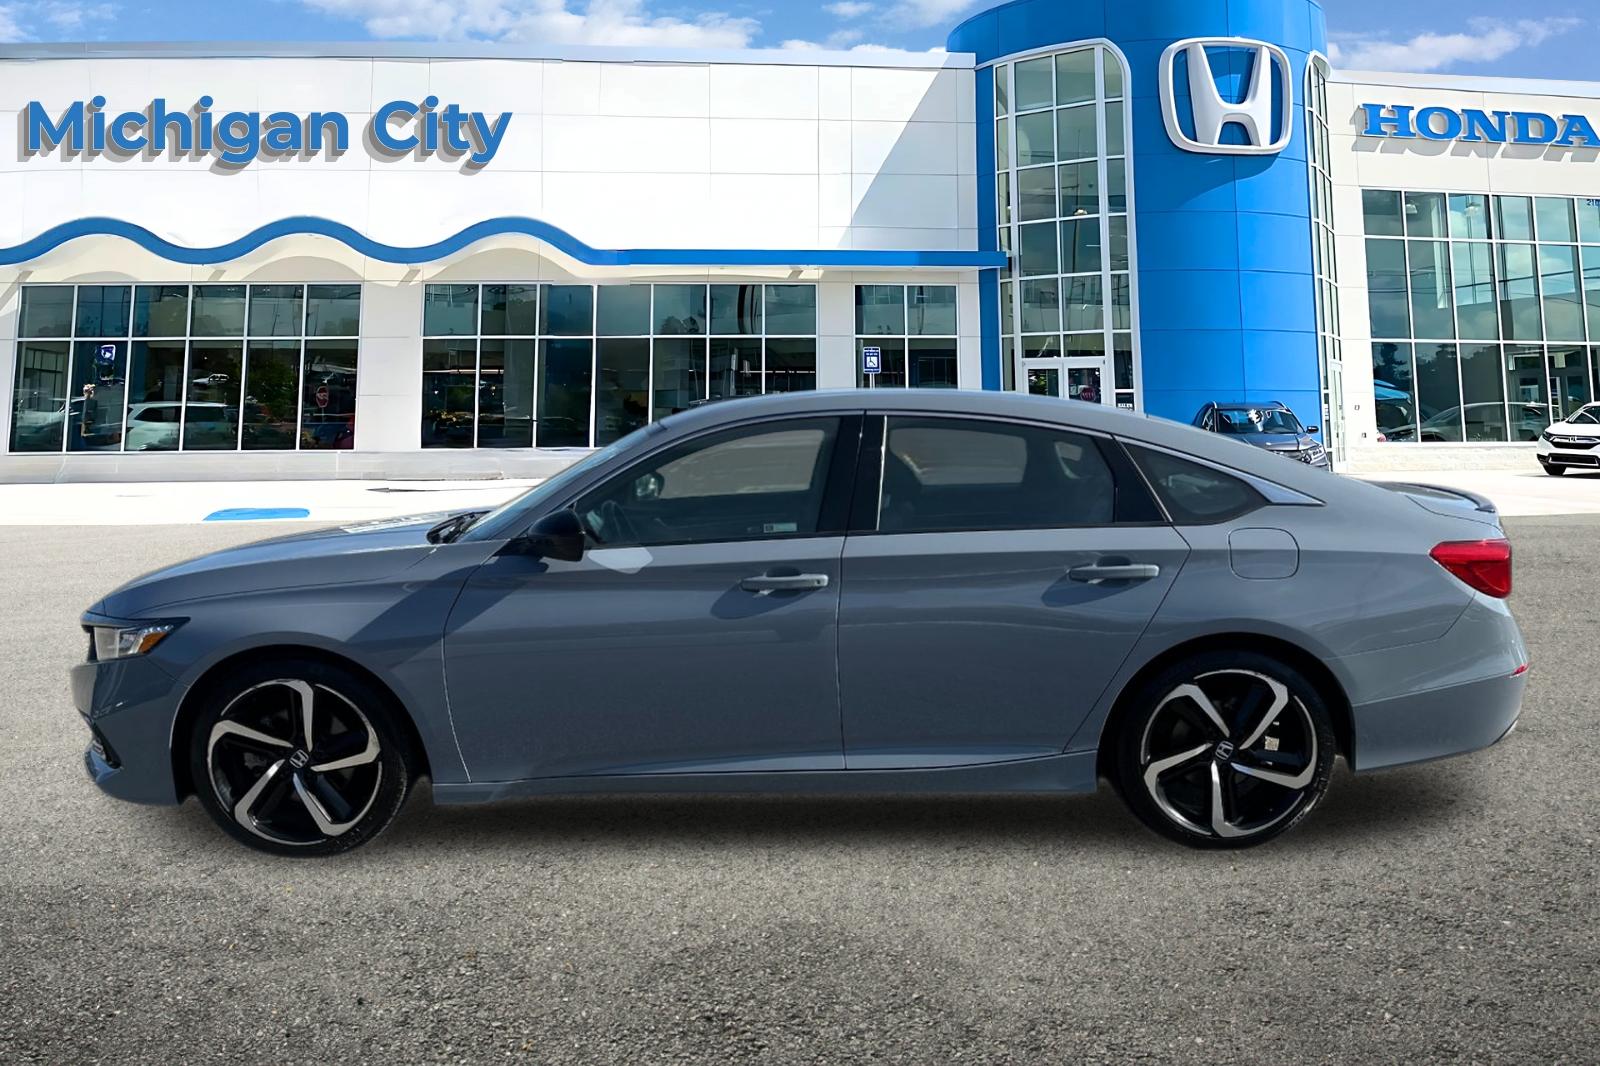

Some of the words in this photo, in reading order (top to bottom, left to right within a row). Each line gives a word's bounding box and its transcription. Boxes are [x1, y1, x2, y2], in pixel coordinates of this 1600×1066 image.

[29, 96, 349, 163] Michigan
[374, 96, 512, 163] City
[1361, 103, 1600, 147] HONDA
